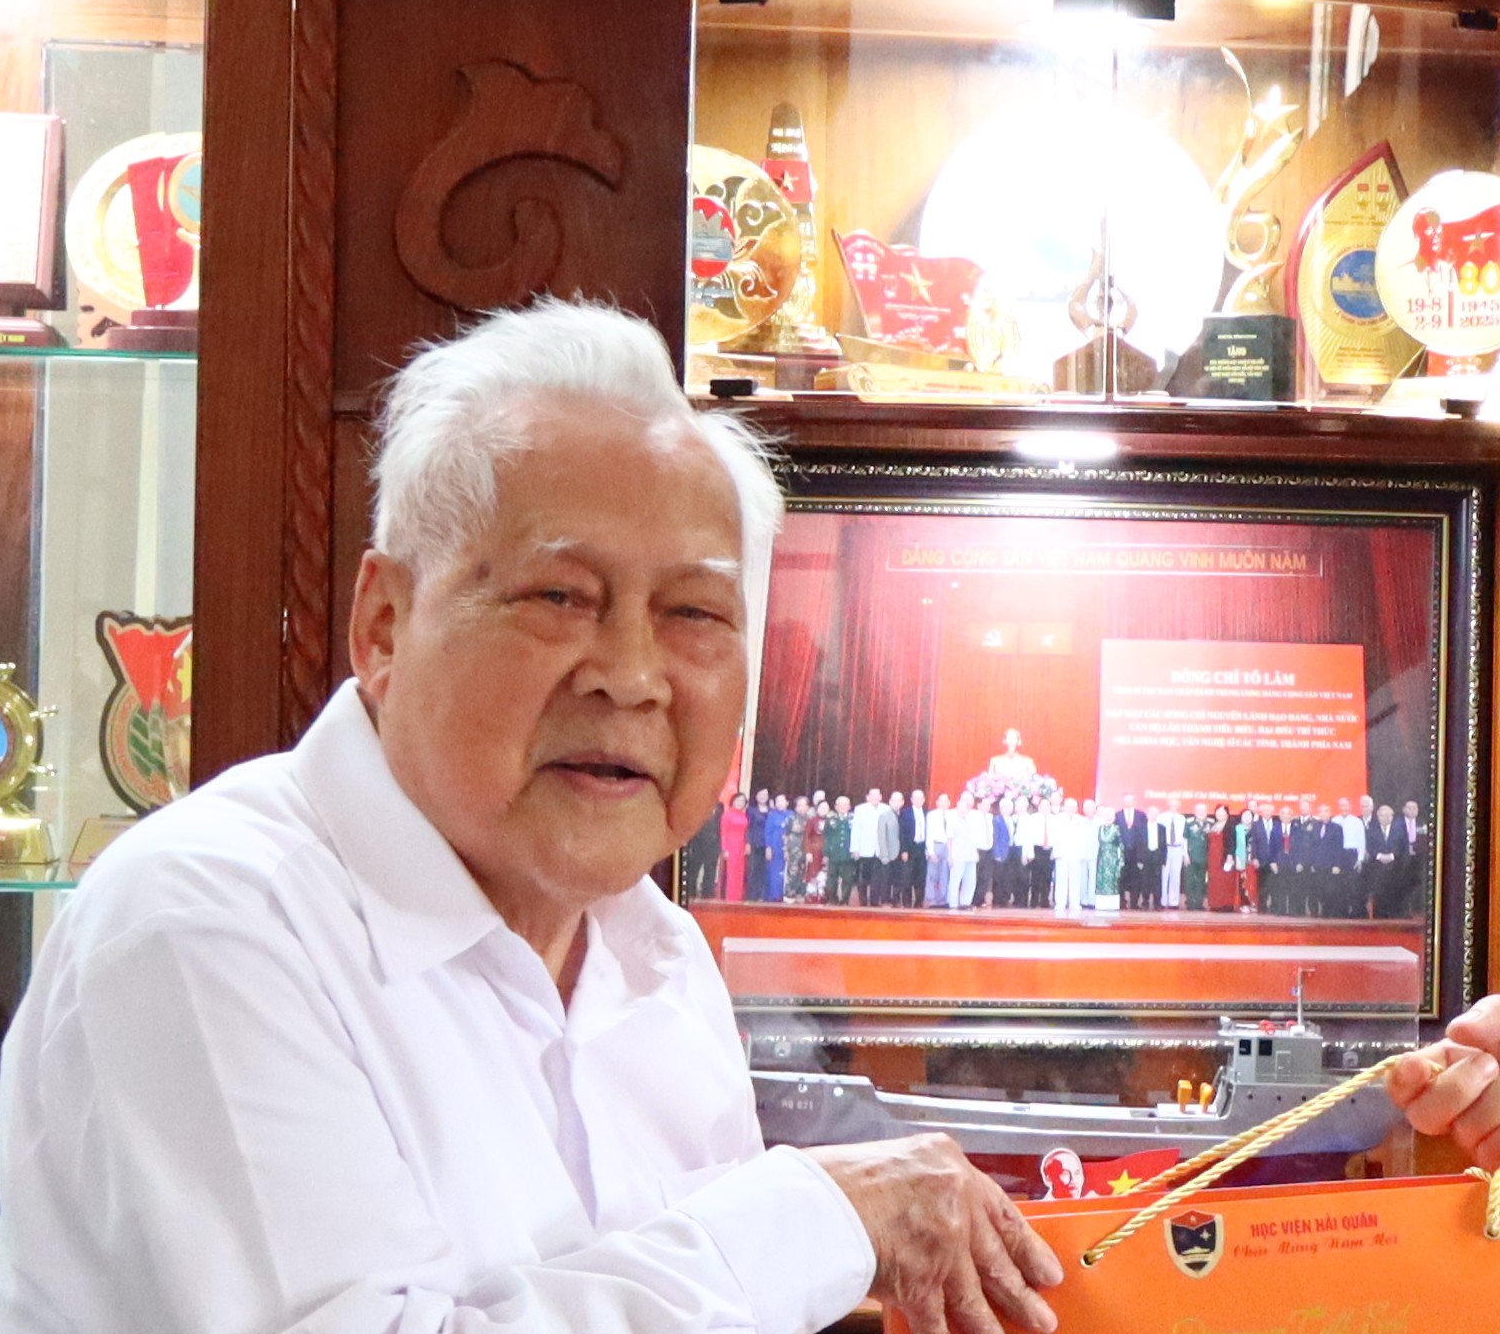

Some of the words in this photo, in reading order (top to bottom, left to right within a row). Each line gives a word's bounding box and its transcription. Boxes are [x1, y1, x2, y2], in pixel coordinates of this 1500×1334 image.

[1406, 296, 1442, 314] 19-8
[1074, 550, 1111, 568] NAM
[1115, 550, 1175, 569] QUANG
[1179, 551, 1215, 569] VINH
[1219, 549, 1266, 571] MUÔN
[1171, 667, 1212, 684] ĐỒNG
[1213, 668, 1239, 685] CHÍ
[1243, 669, 1262, 685] TÔ
[1264, 670, 1296, 686] LÂM
[1333, 740, 1353, 750] NAM
[1250, 1222, 1277, 1240] HỌC
[1281, 1218, 1312, 1237] VIỆN
[1315, 1212, 1337, 1233] HẢI
[1342, 1210, 1378, 1232] QUÂN
